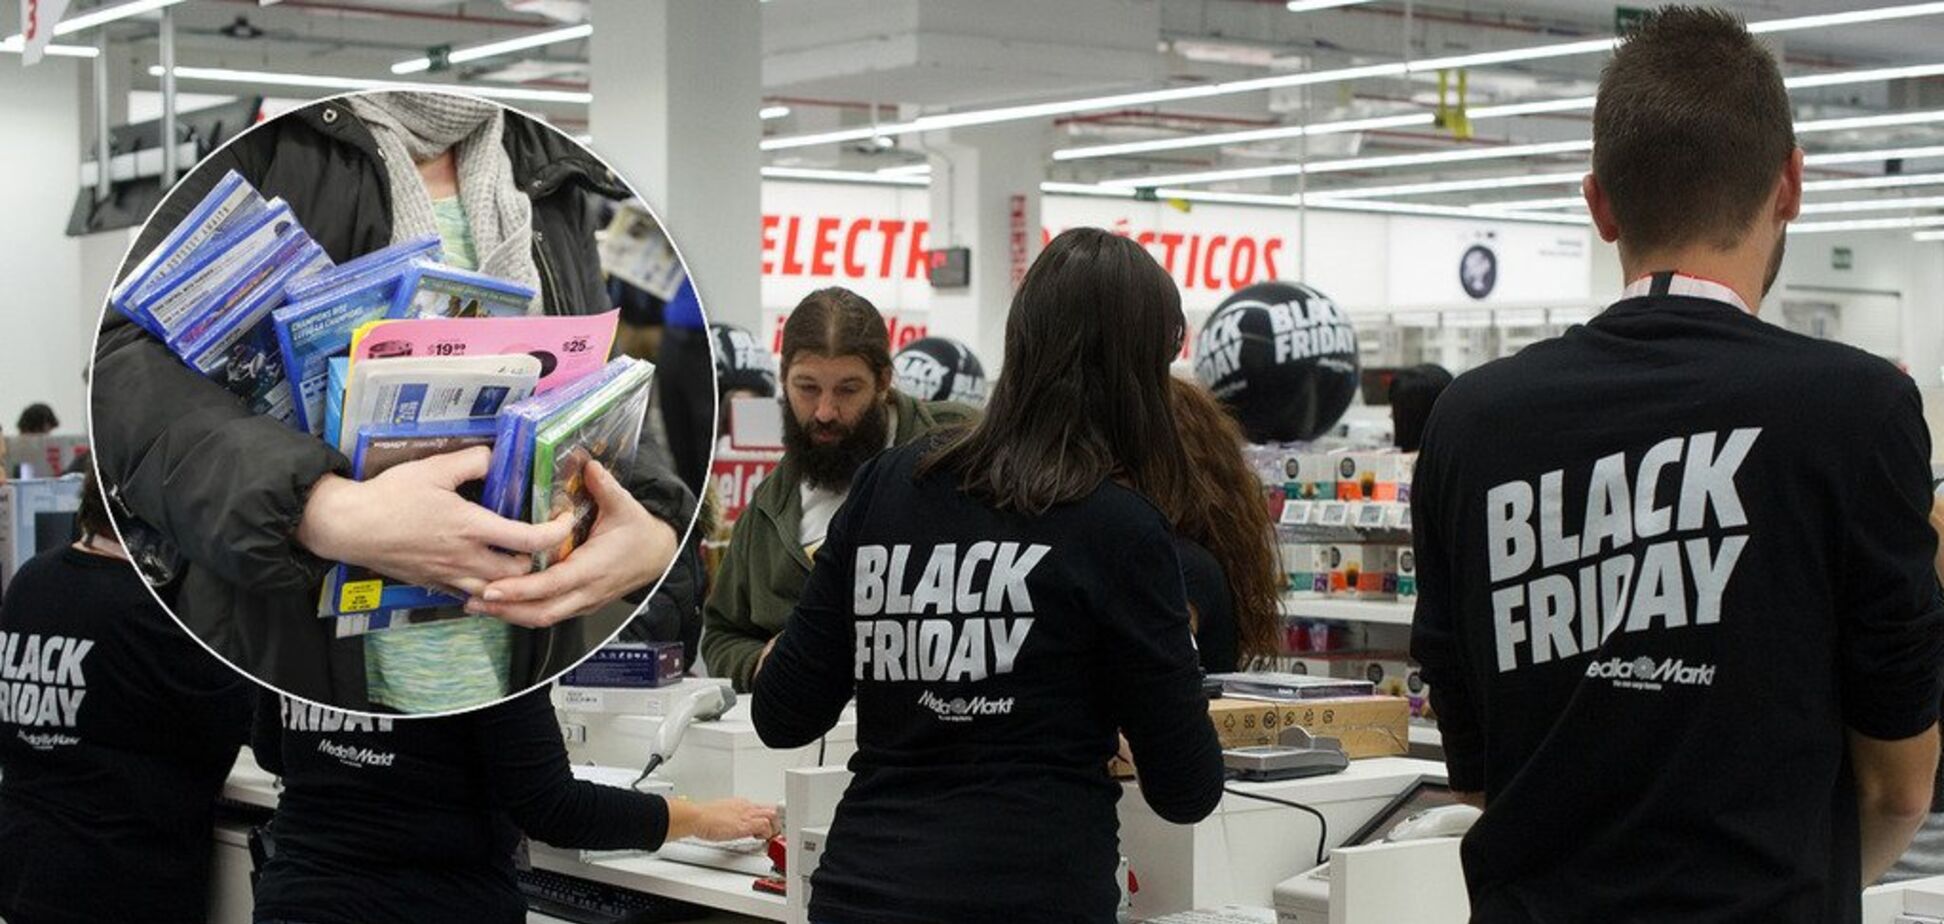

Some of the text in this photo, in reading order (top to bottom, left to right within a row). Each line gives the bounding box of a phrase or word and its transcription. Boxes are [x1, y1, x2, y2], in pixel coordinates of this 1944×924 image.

[1487, 427, 1763, 583] BLACK
[853, 541, 1052, 616] BLACK
[1492, 535, 1750, 673] FRIDAY
[854, 617, 1036, 683] FRIDAY
[0, 681, 86, 727] RIDAY
